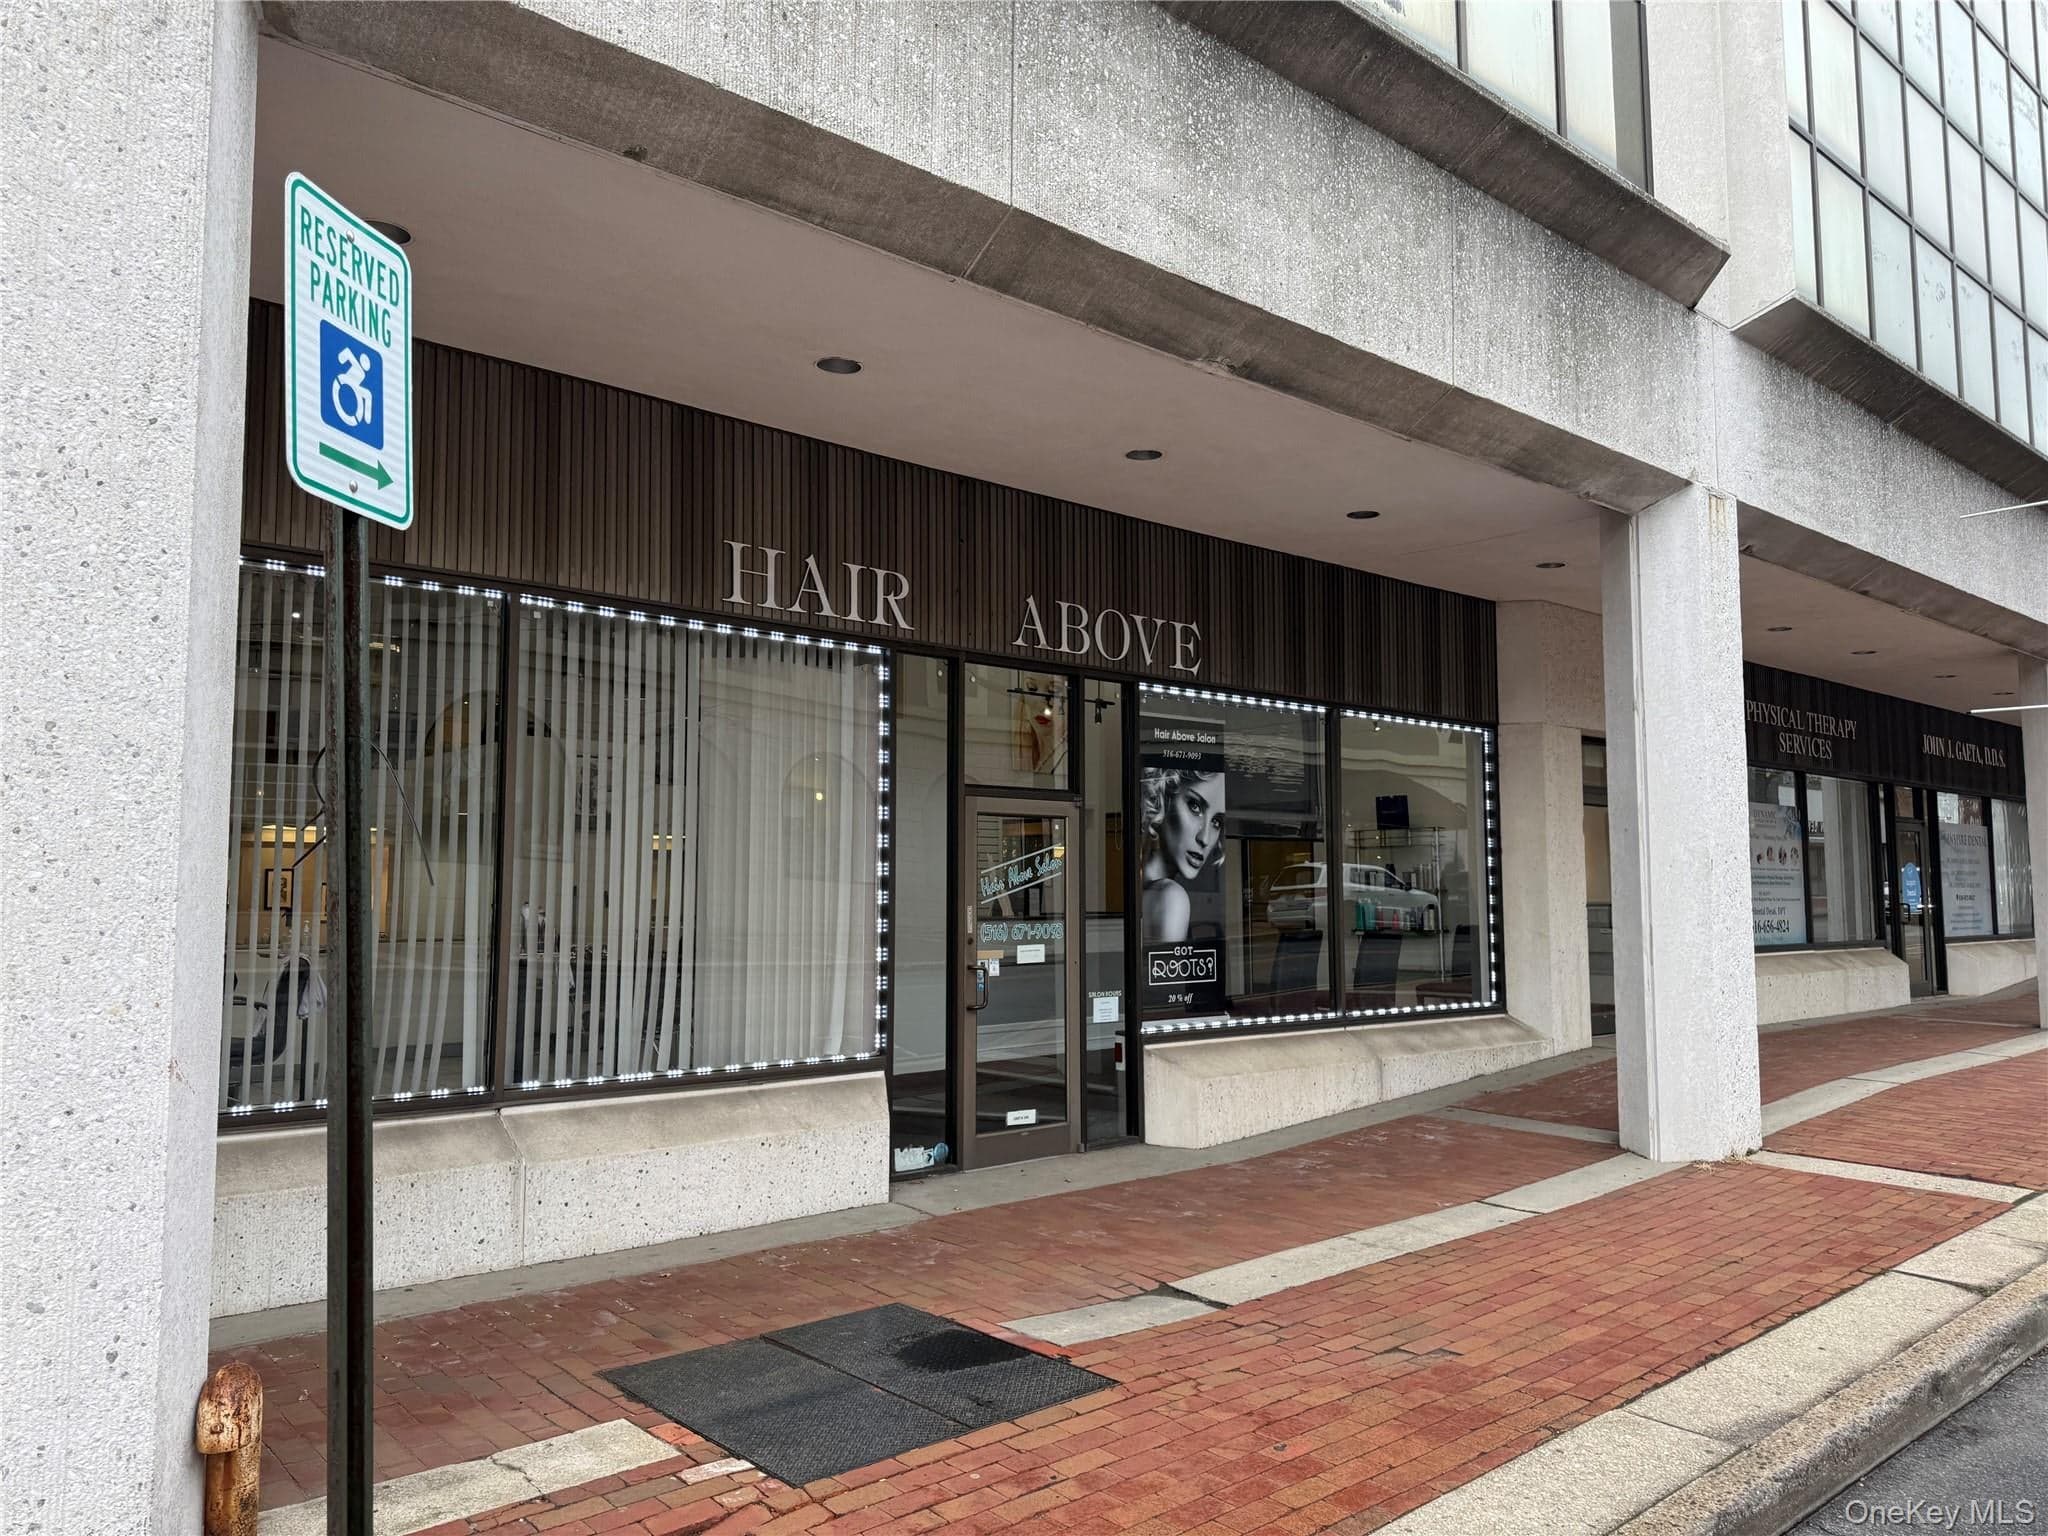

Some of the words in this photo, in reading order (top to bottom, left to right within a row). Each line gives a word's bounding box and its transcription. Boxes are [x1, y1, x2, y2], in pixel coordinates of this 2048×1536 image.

[300, 206, 400, 307] RESERVED
[310, 260, 392, 348] PARKING
[722, 539, 915, 630] HAIR
[1011, 594, 1202, 676] ABOVE
[1746, 700, 1805, 730] PHYSICAL
[1806, 711, 1857, 740] THERAPY
[1154, 727, 1170, 740] Hair
[1171, 730, 1196, 742] Above
[1197, 732, 1216, 744] Salon
[1779, 732, 1832, 760] SERVICES
[1922, 734, 1946, 758] JOHN
[1947, 739, 1955, 759] J.
[981, 877, 1005, 897] Hair
[1008, 864, 1034, 888] Above
[1035, 853, 1064, 876] Salon
[981, 922, 1009, 943] (516)
[1753, 919, 1790, 934] 16-656-4824
[1174, 946, 1194, 956] GOT
[1152, 957, 1214, 978] ROOTS?
[1168, 994, 1176, 1003] 20
[1184, 993, 1194, 1004] off
